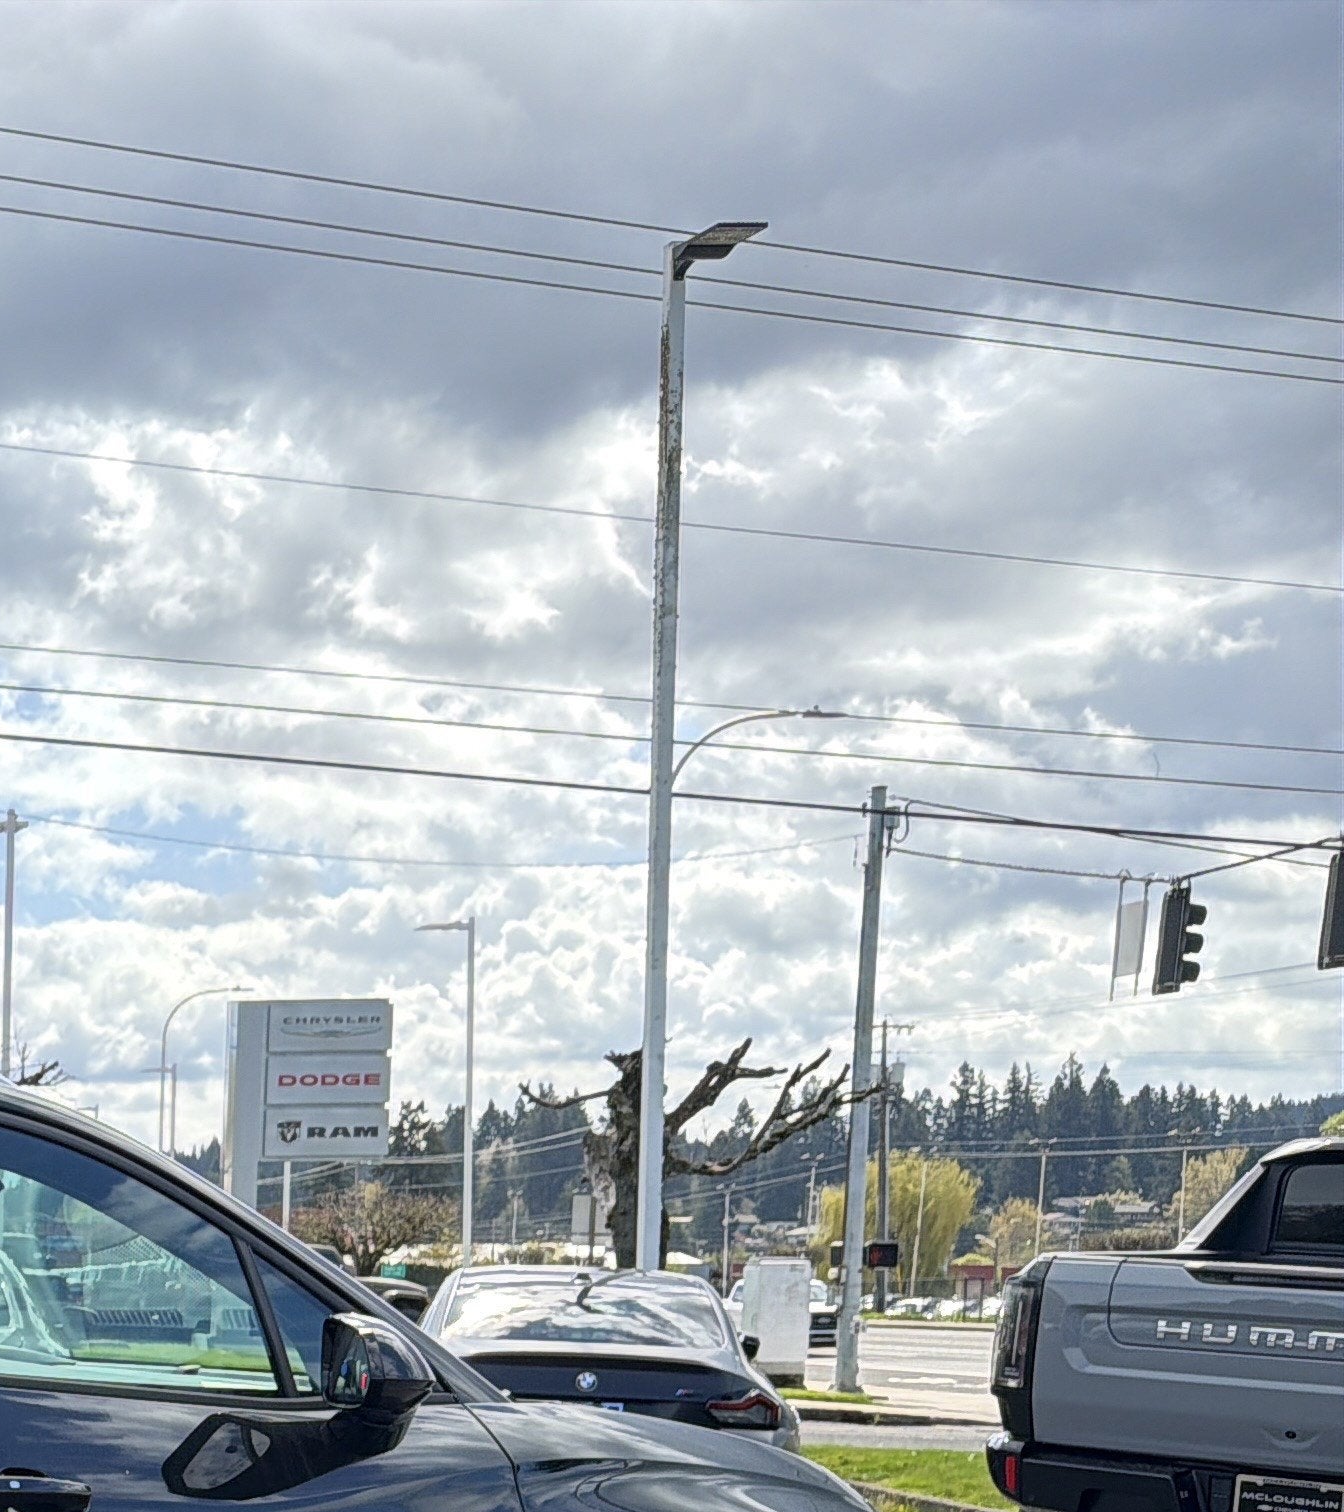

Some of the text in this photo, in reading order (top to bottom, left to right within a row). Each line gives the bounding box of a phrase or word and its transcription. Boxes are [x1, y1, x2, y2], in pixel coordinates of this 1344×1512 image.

[282, 1015, 382, 1025] CHRYSLER
[277, 1072, 382, 1087] DODGE
[306, 1125, 379, 1139] RAM
[1241, 1491, 1340, 1510] MCLOUGHLIN
